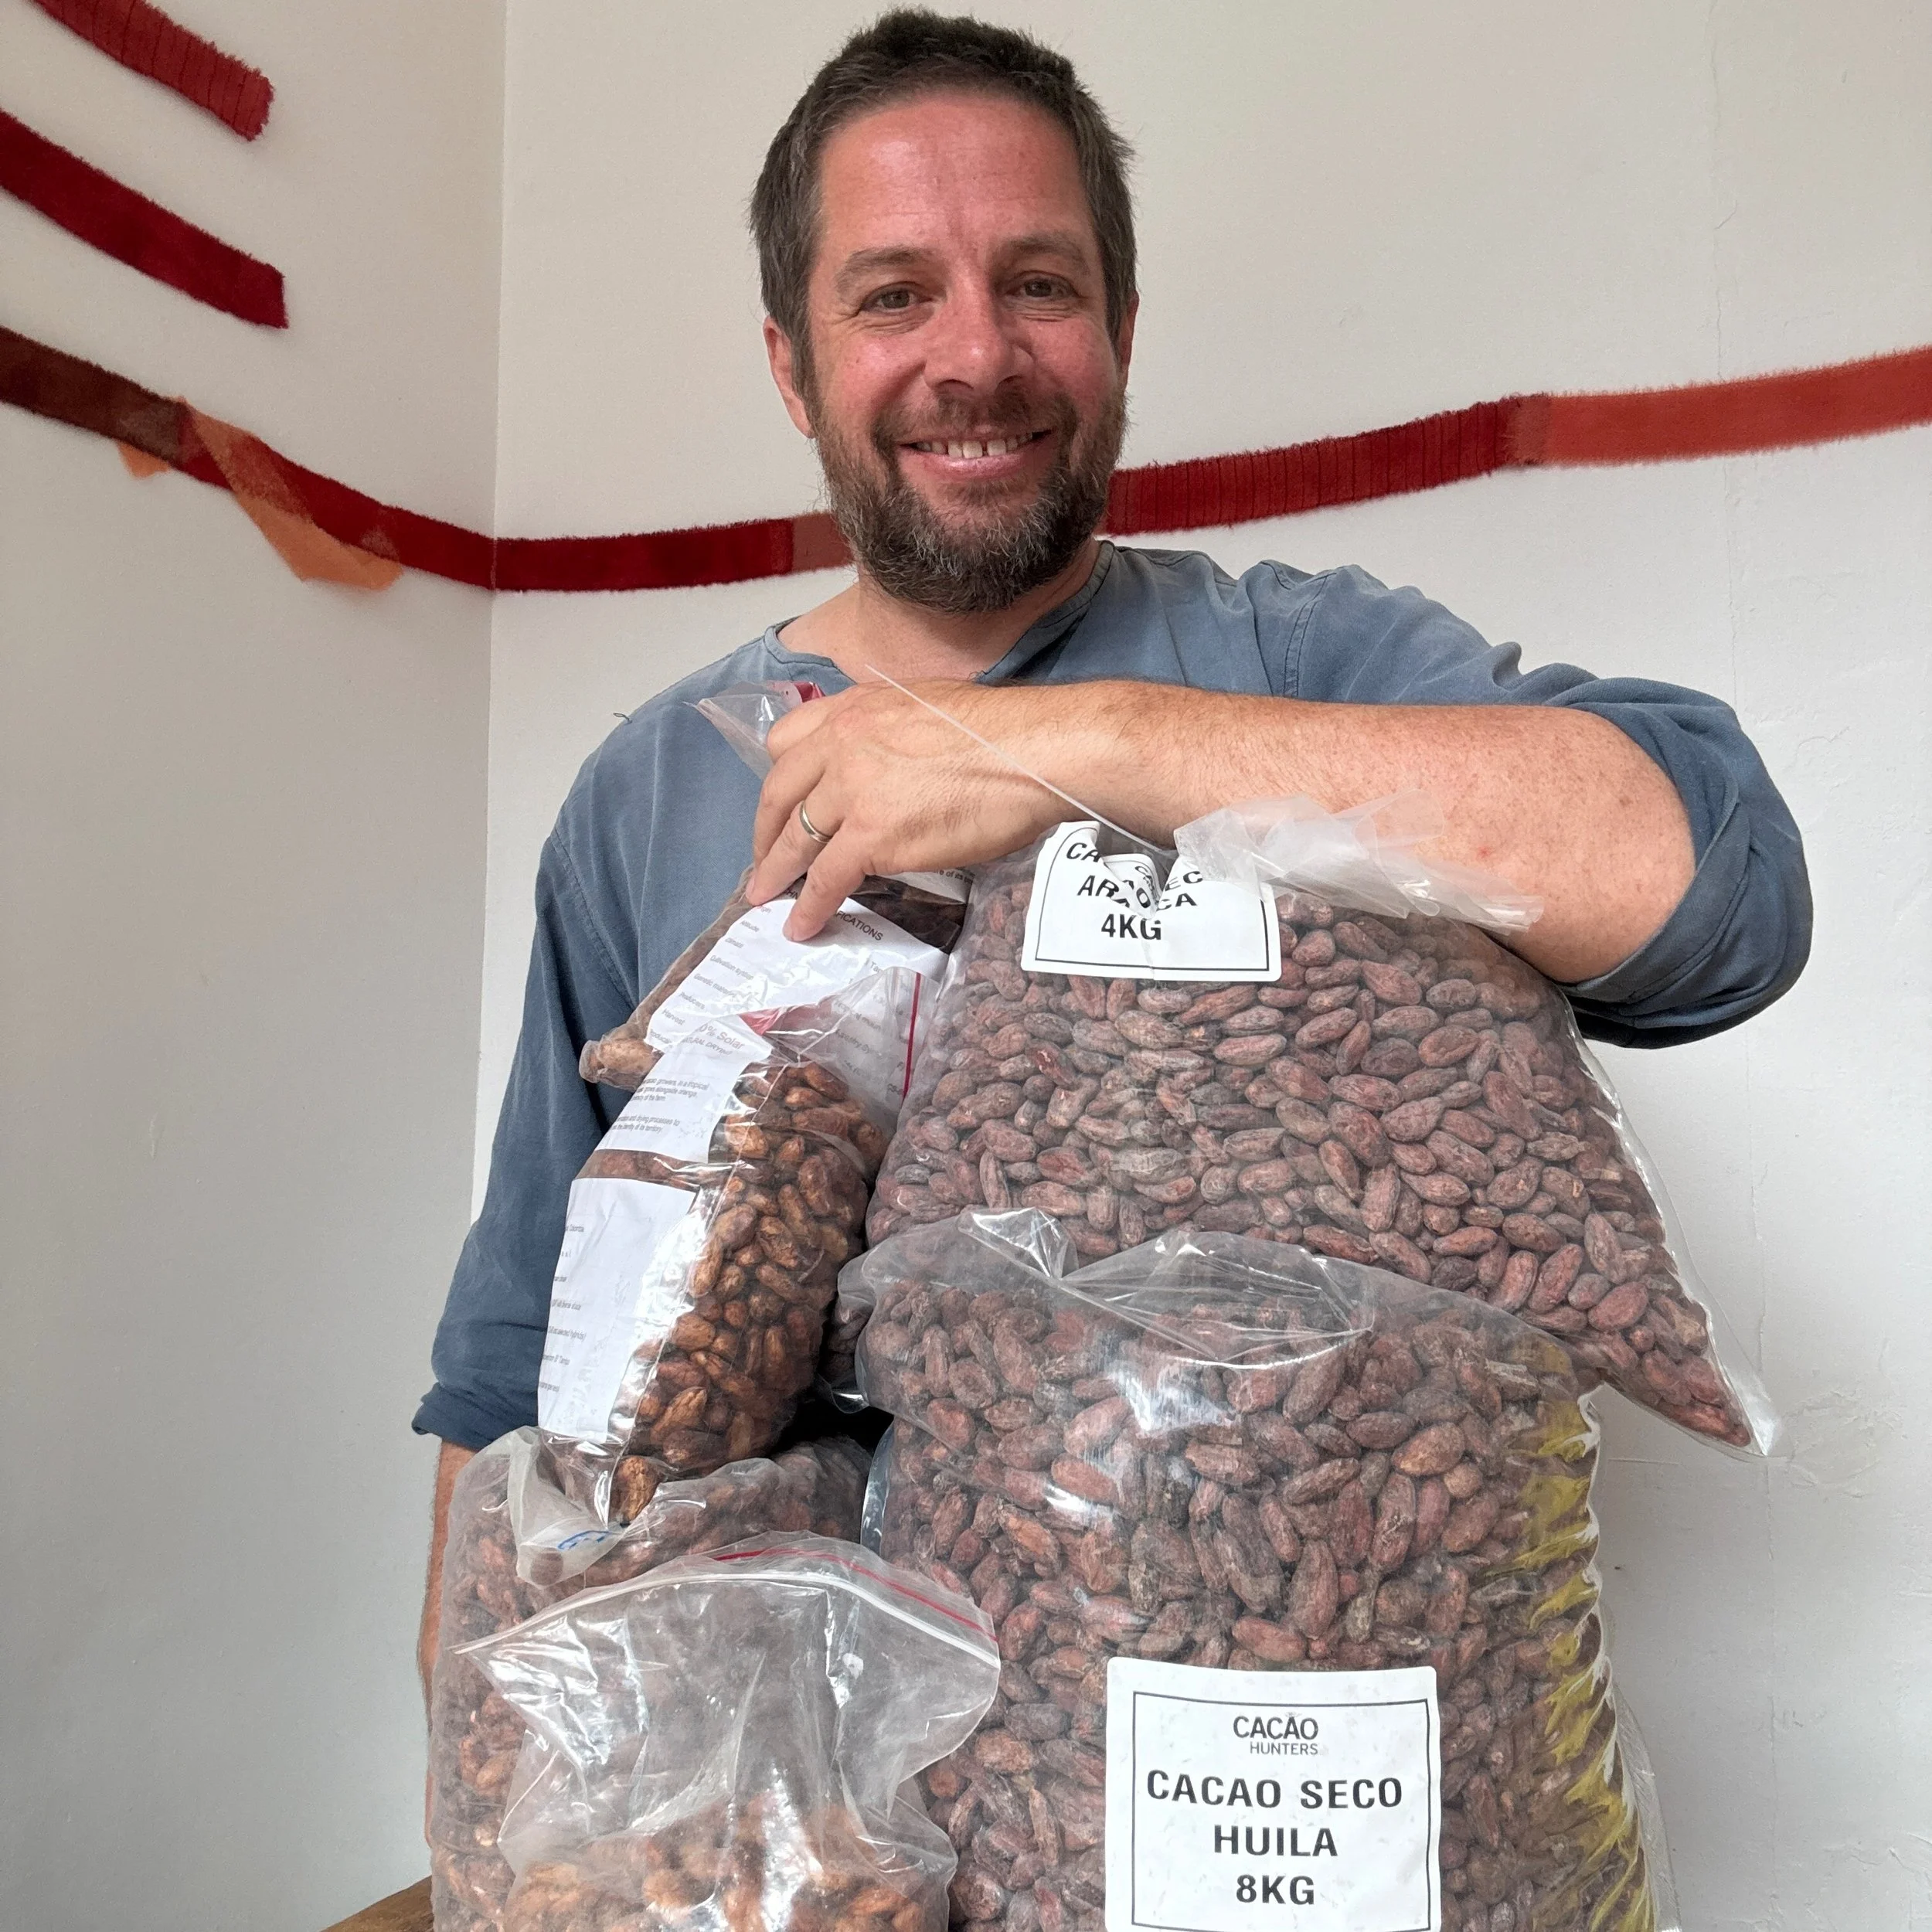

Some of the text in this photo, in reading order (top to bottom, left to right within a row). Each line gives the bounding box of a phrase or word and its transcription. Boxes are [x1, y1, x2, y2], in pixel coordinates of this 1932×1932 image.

[835, 910, 884, 941] FICATIONS
[1100, 913, 1162, 941] 4KG
[717, 1032, 746, 1050] Solar
[1250, 1742, 1319, 1756] HUNTERS
[1146, 1769, 1403, 1809] CACAO SECO
[1214, 1825, 1338, 1857] HUILA
[1236, 1873, 1315, 1905] 8KG
